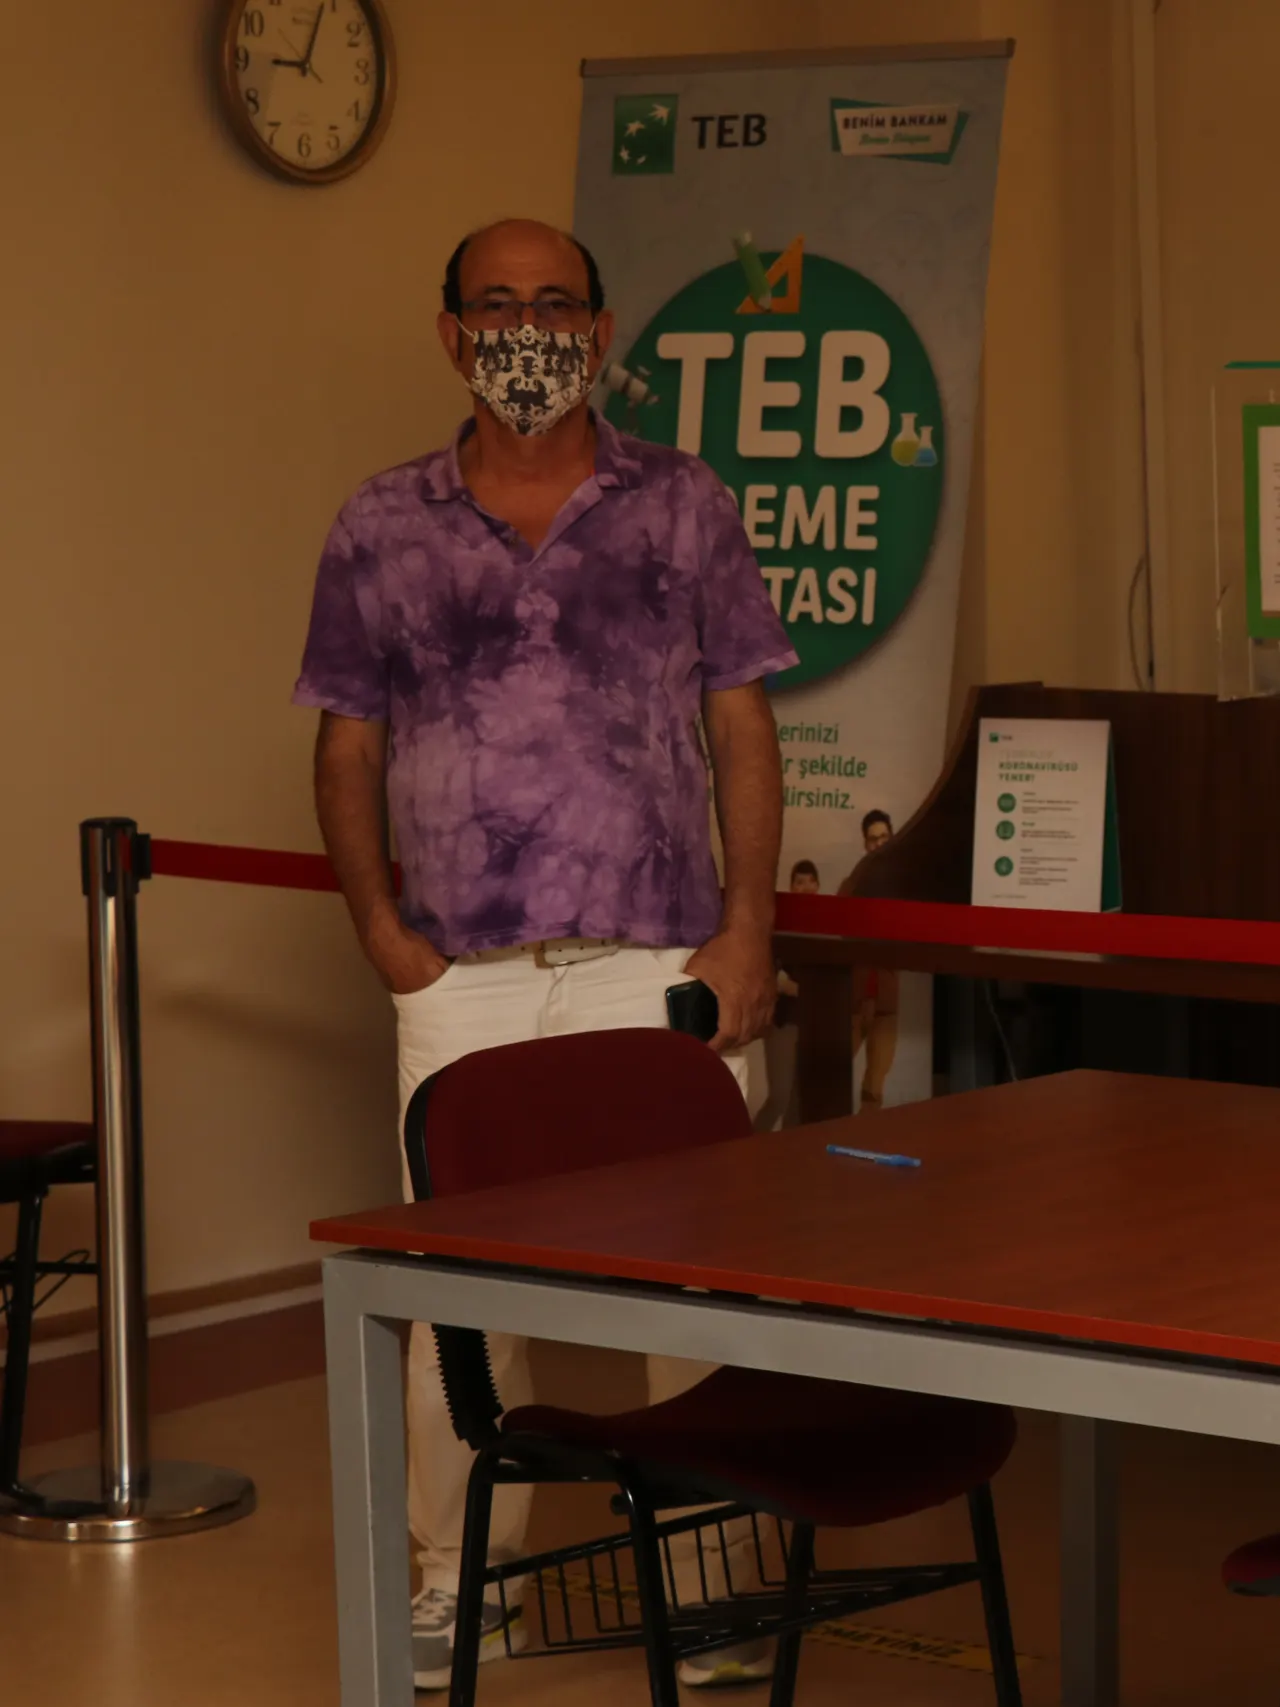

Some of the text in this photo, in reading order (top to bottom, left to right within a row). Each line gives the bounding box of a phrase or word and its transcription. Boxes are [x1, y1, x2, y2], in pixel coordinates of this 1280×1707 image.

[241, 9, 265, 37] 10
[345, 21, 362, 47] 2
[234, 45, 249, 72] 9
[353, 58, 370, 85] 3
[245, 87, 260, 115] 8
[267, 121, 282, 146] 7
[692, 113, 767, 150] TEB
[843, 112, 948, 129] BENİM BANKAM
[297, 132, 311, 158] 6
[326, 124, 341, 150] 5
[656, 330, 891, 459] TEB
[727, 484, 880, 551] EME
[760, 566, 878, 625] TASI
[778, 722, 839, 745] erinizi
[799, 753, 868, 779] şekilde
[783, 784, 856, 810] lirsiniz.
